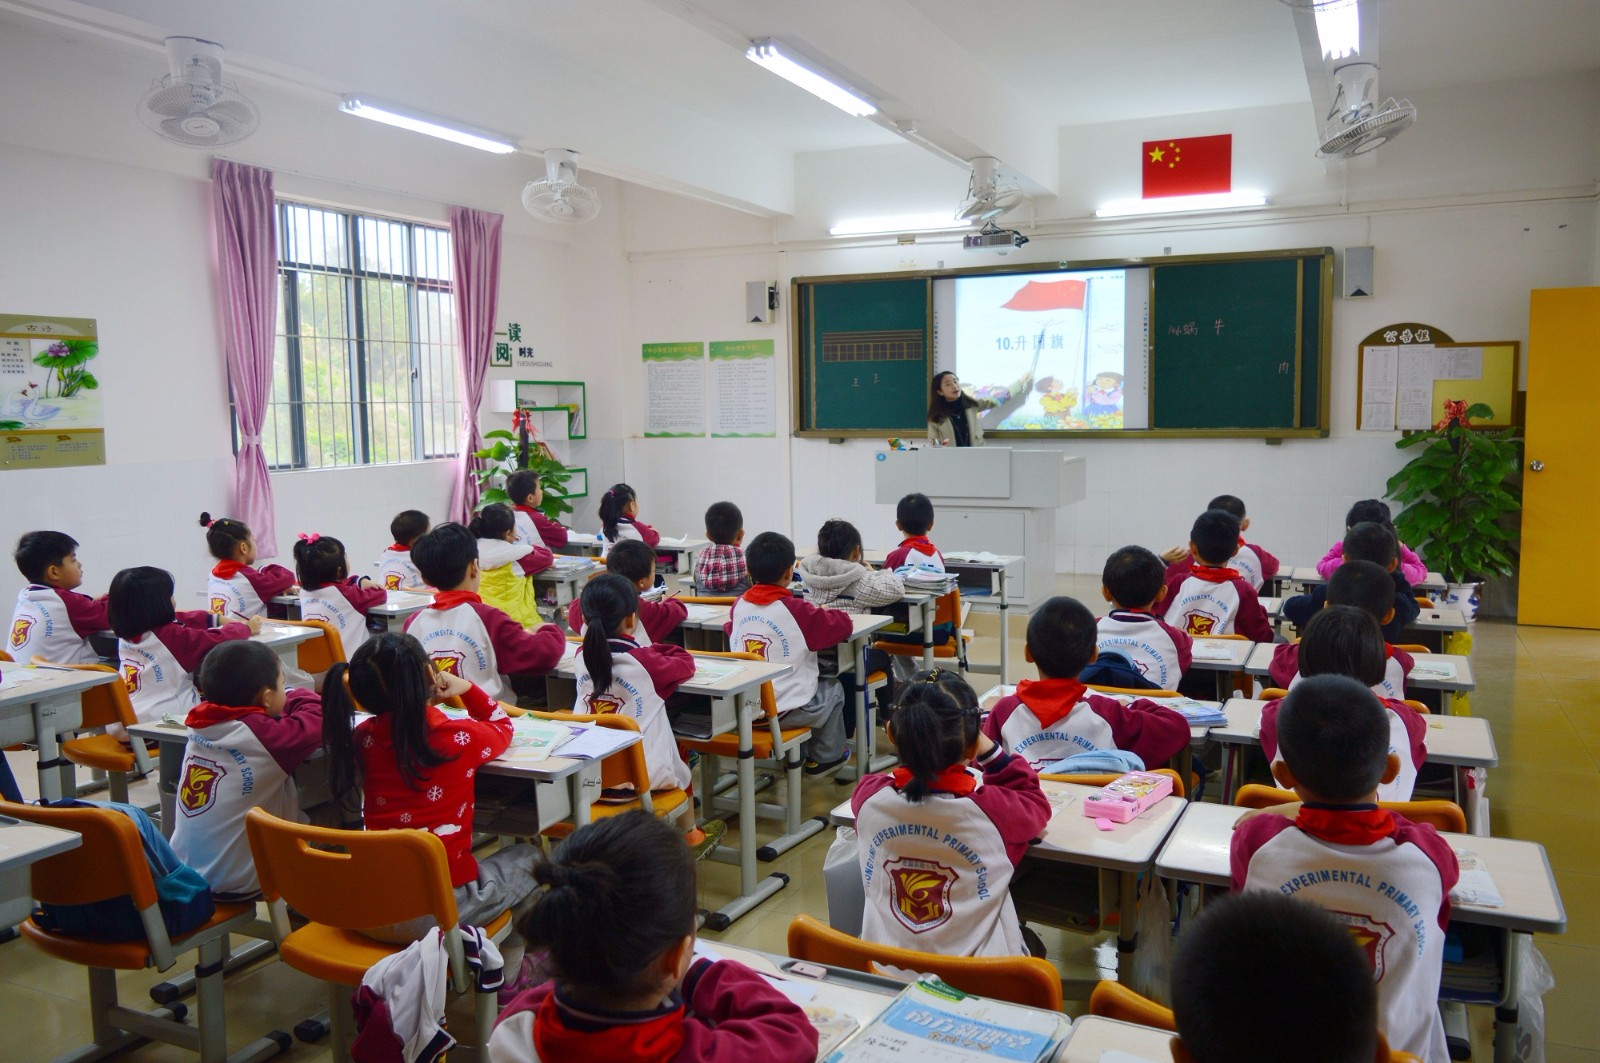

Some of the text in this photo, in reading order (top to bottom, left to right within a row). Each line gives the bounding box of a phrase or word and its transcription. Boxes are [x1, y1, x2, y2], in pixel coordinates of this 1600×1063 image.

[508, 322, 522, 343] 读
[1383, 328, 1431, 344] 公告栏
[496, 341, 510, 362] 阅
[518, 346, 535, 359] 时光
[1140, 643, 1164, 663] PRIMARY
[1159, 664, 1168, 686] SCHOOL
[1014, 731, 1099, 754] EXPERIMENTAL PRIMA
[241, 766, 255, 797] SCHOOL
[872, 823, 939, 848] EXPERIMENTAL
[942, 833, 982, 866] PRIMARY
[1281, 869, 1372, 896] EXPERIMENTAL
[1376, 881, 1421, 919] PRIMARY
